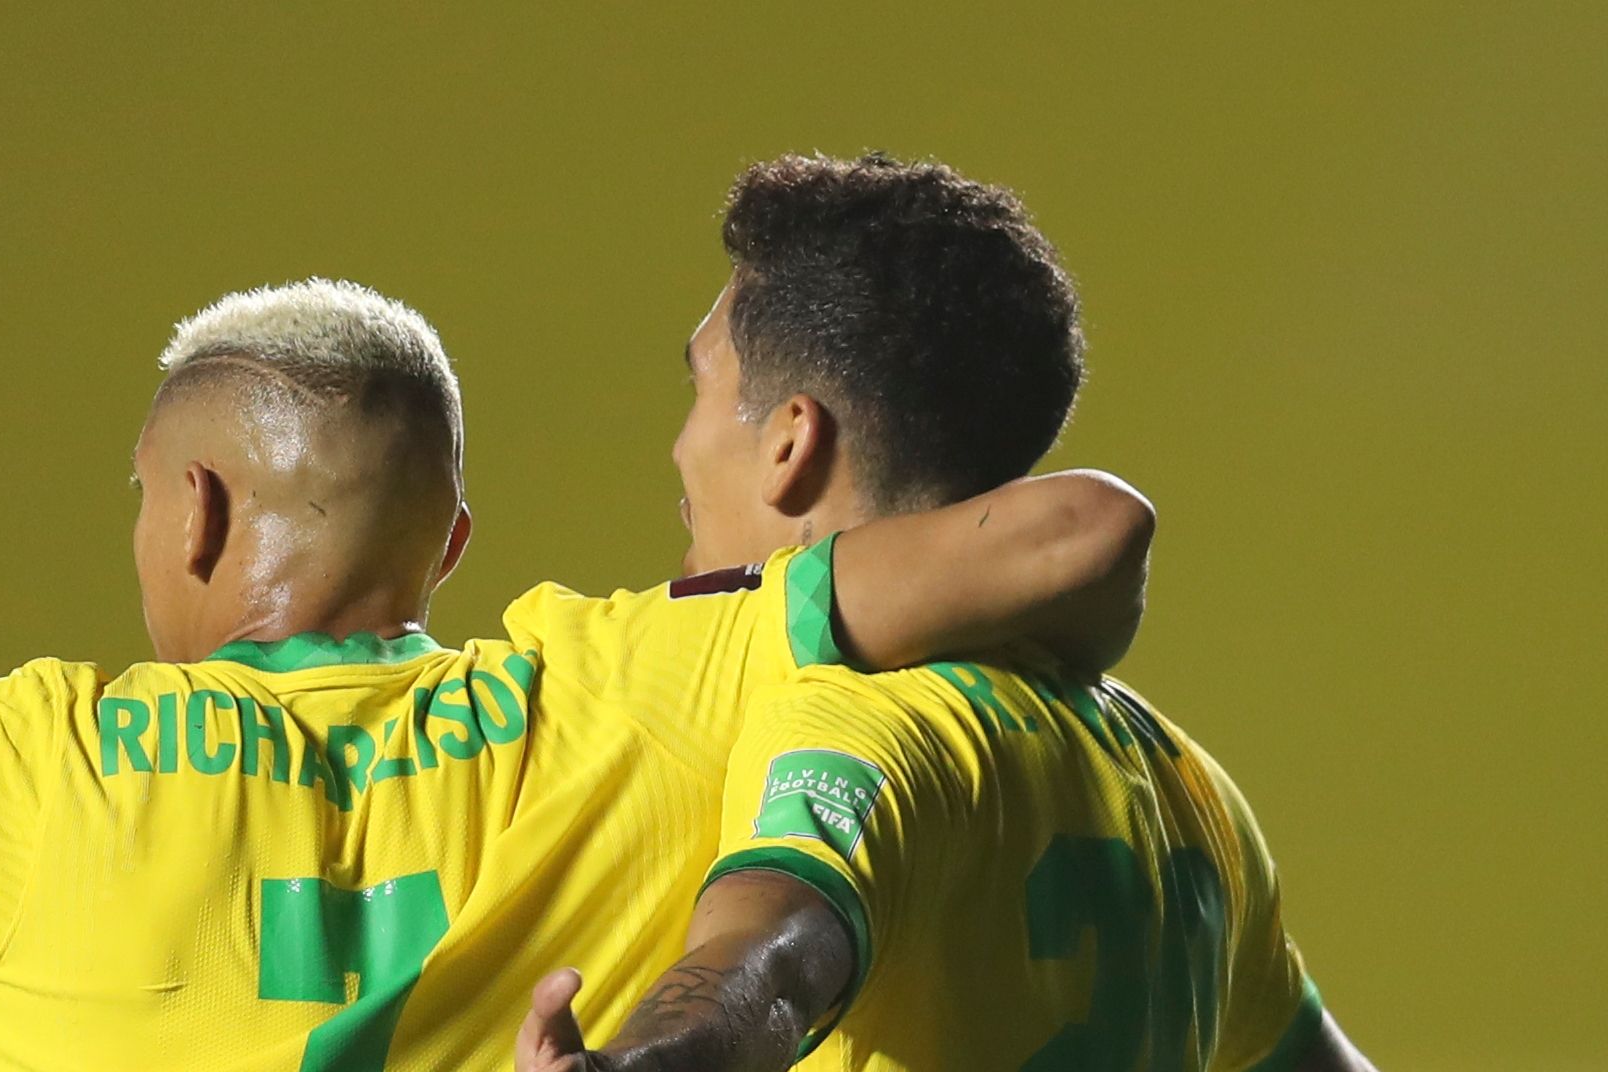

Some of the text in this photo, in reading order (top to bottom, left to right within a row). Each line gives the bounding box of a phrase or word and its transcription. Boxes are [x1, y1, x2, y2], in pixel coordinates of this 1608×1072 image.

[770, 779, 860, 810] FOOTBALL
[773, 769, 866, 800] LIVING
[813, 803, 851, 834] FIFA
